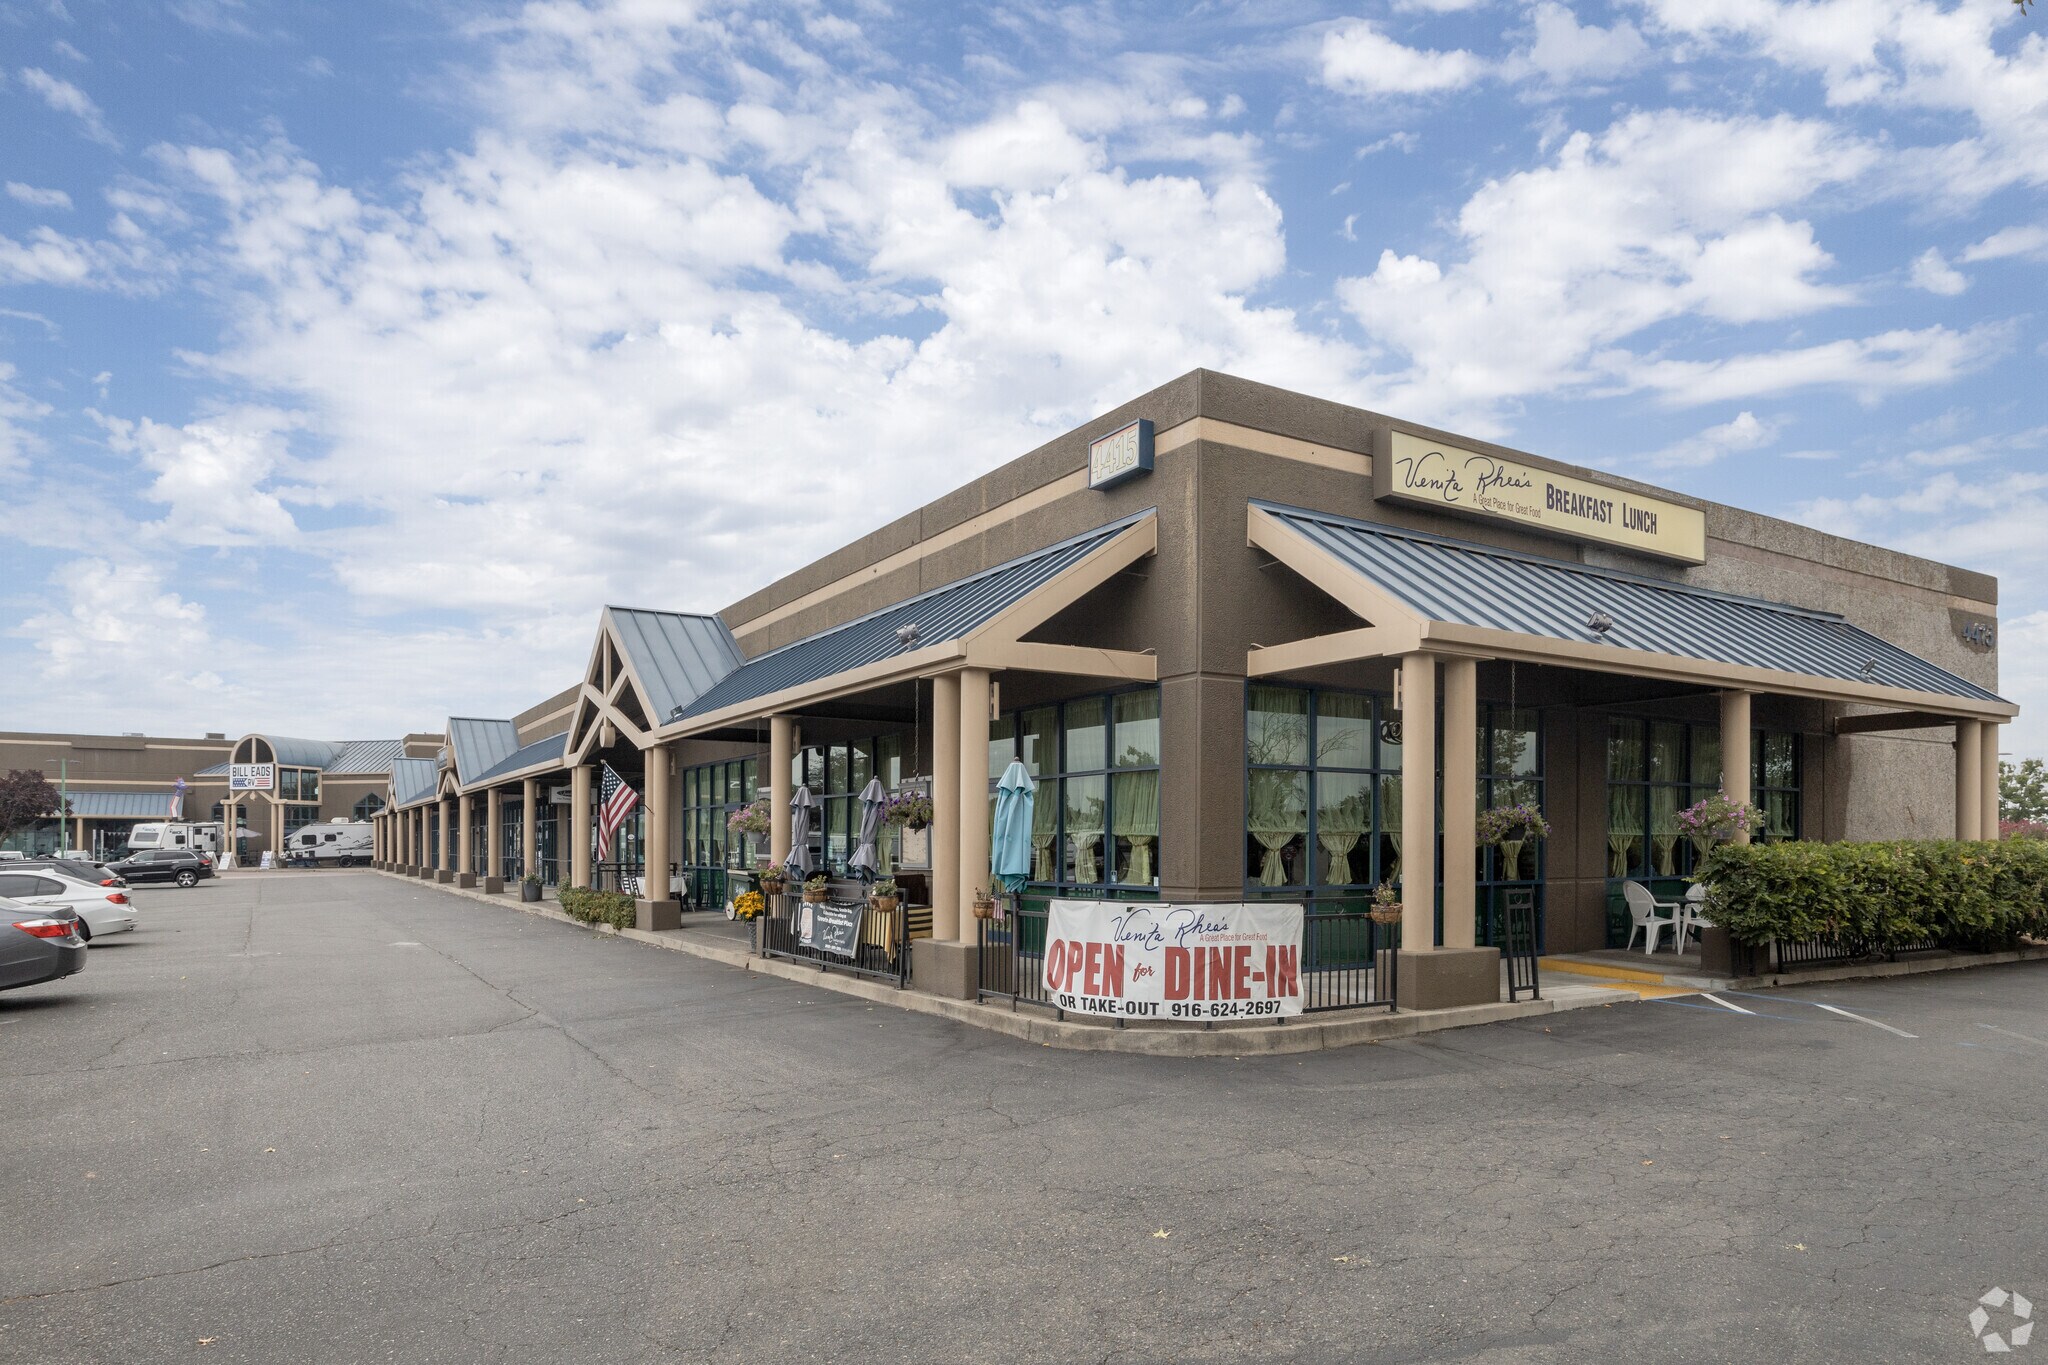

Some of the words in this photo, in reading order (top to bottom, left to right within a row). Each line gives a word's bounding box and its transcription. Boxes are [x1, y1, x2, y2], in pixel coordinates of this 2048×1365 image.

[1092, 427, 1137, 479] 4415
[1395, 451, 1464, 502] Venita
[1464, 456, 1532, 513] Rhea's
[1473, 492, 1478, 504] A
[1479, 493, 1492, 508] Great
[1493, 497, 1506, 510] Place
[1515, 502, 1528, 516] Great
[1529, 505, 1541, 519] Food
[1546, 483, 1613, 524] BREAKFAST
[1623, 502, 1657, 535] LUNCH
[232, 766, 248, 777] BILL
[251, 766, 271, 777] EADS
[247, 778, 255, 787] RV
[1111, 908, 1165, 951] Venita
[1166, 908, 1229, 949] Rhea's
[1205, 933, 1220, 942] Great
[1220, 933, 1234, 942] Place
[1242, 932, 1255, 941] Great
[1256, 932, 1268, 941] Food
[1047, 938, 1124, 998] OPEN
[1132, 962, 1155, 982] for
[1164, 944, 1298, 1001] DINE-IN
[1060, 994, 1076, 1010] OR
[1081, 996, 1159, 1016] TAKE-OUT
[1172, 1000, 1281, 1017] 916-624-2697
